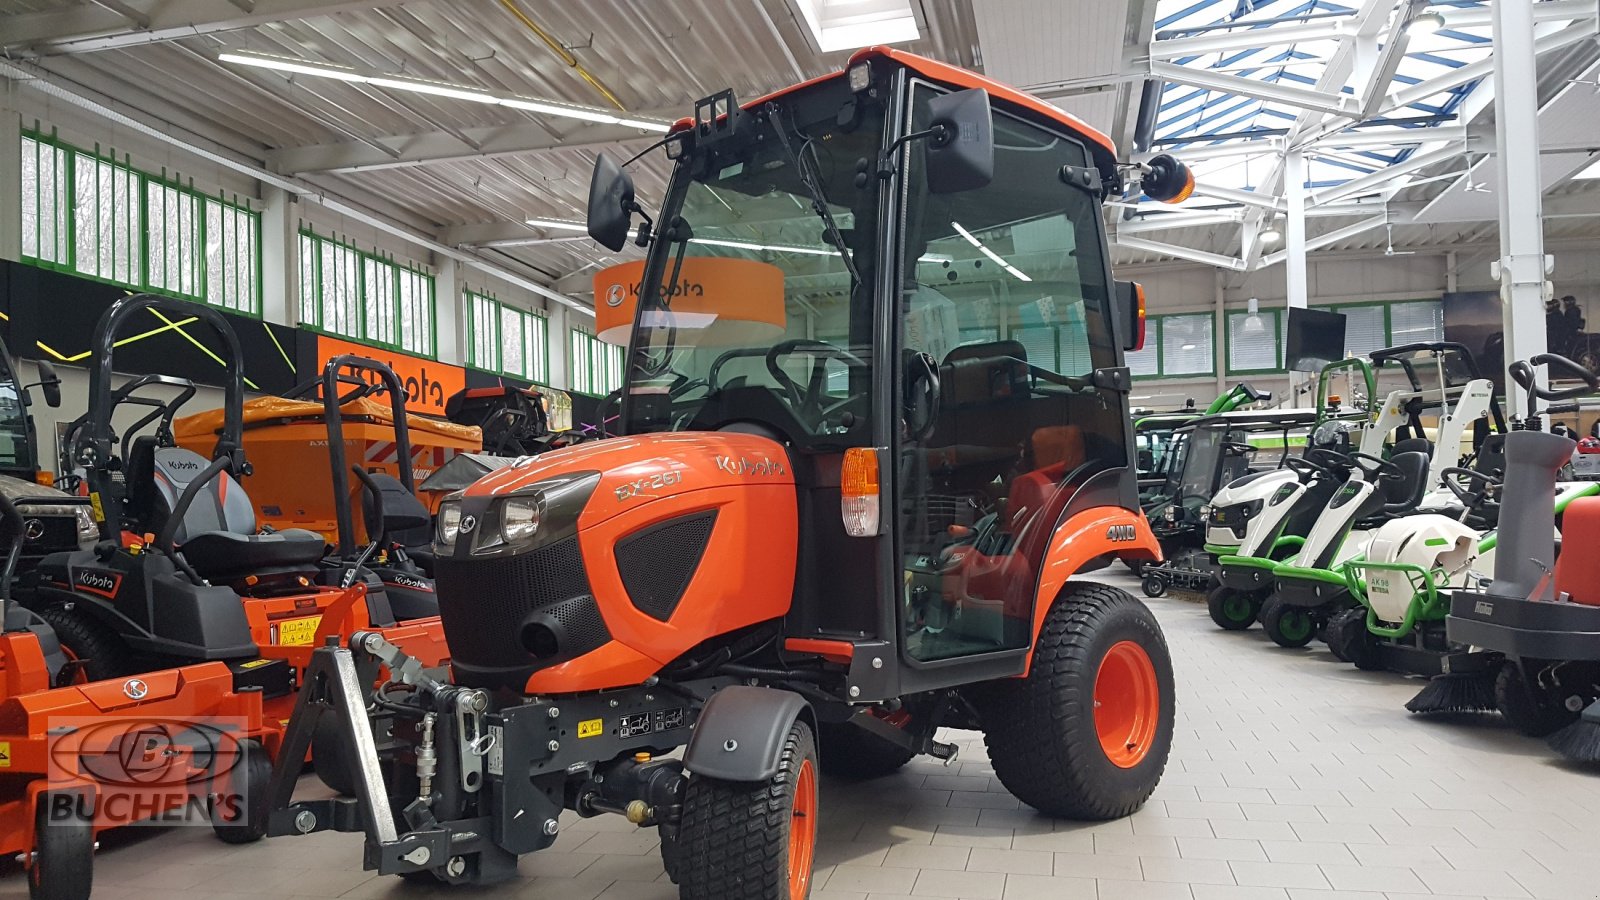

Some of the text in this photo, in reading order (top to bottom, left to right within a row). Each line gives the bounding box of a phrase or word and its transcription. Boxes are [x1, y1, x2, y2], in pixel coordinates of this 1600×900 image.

[629, 279, 704, 297] Kbota
[350, 352, 444, 408] uota
[168, 461, 198, 470] Kubota
[715, 455, 785, 475] Kubota
[1106, 524, 1136, 542] 4WD
[80, 571, 113, 589] Kubota
[394, 575, 426, 589] Kubota
